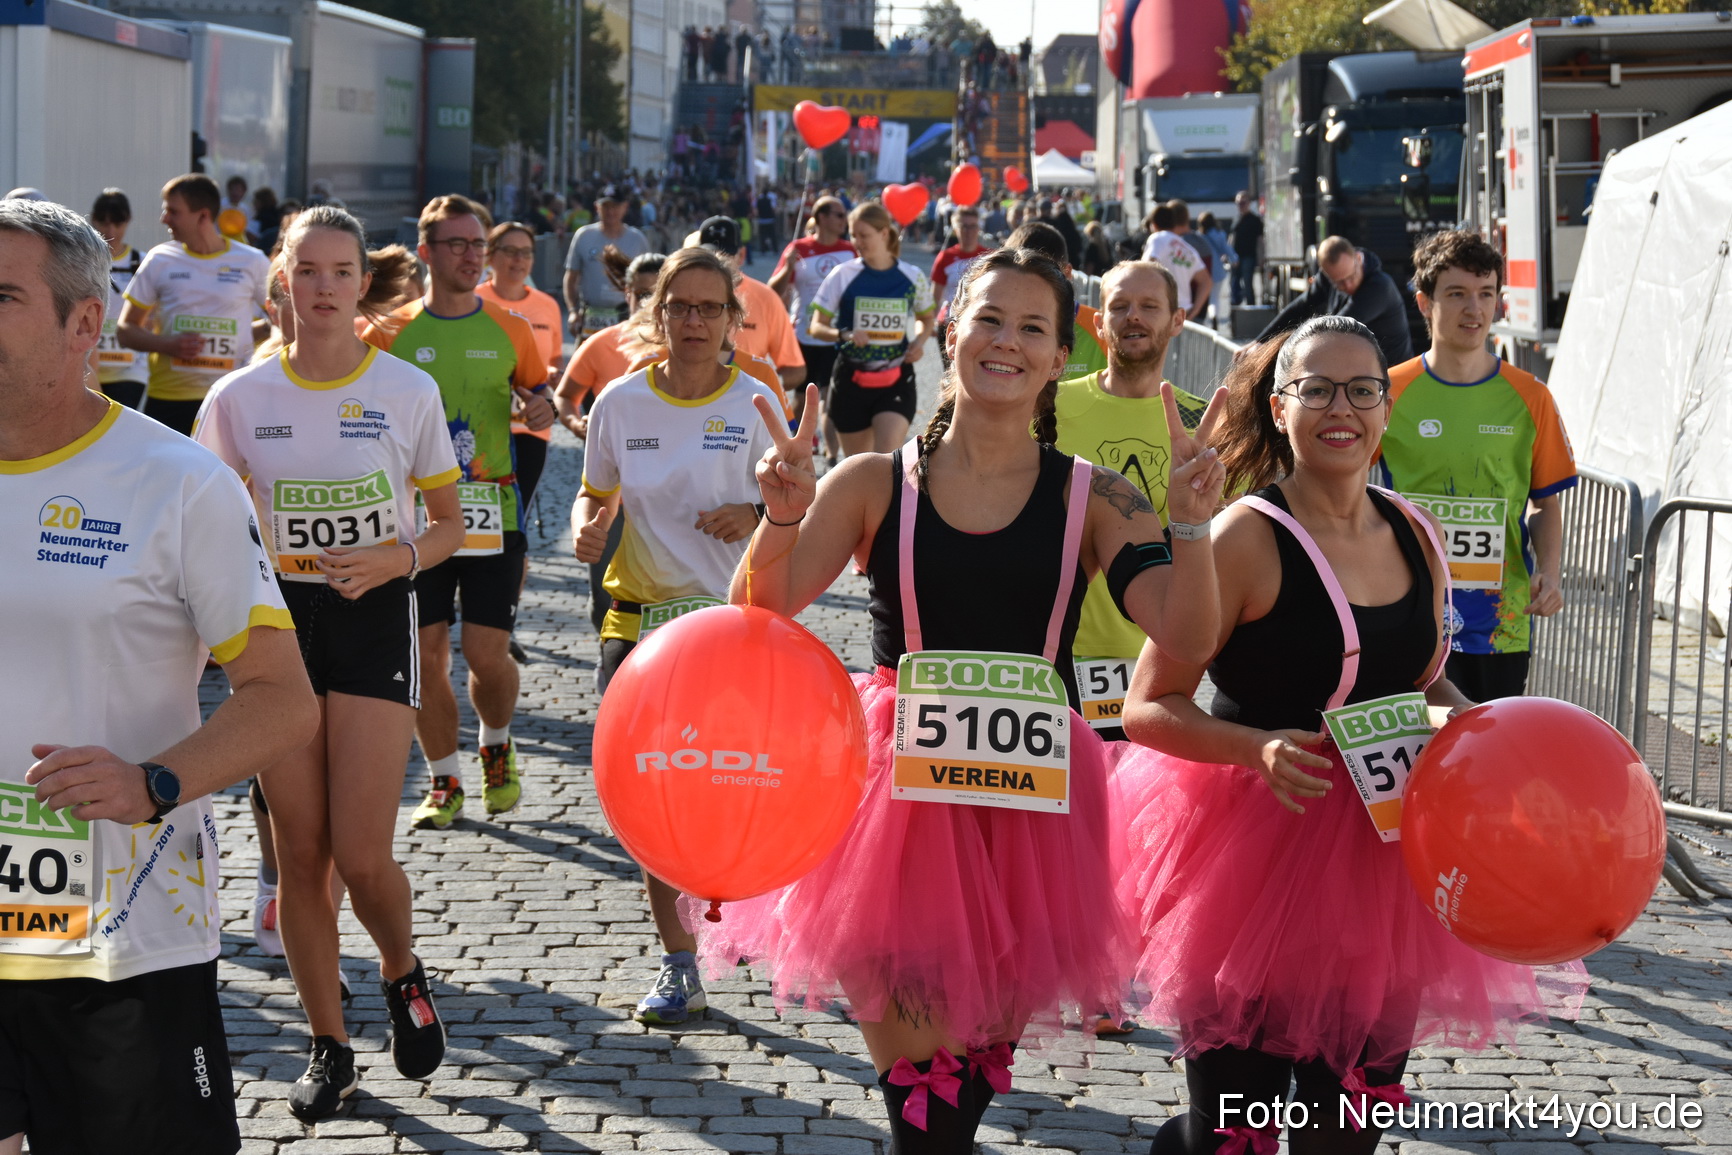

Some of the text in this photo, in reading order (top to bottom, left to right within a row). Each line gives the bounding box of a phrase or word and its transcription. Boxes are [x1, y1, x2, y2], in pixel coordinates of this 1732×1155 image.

[820, 91, 889, 110] START
[180, 316, 231, 333] BOCK
[861, 314, 900, 329] 5209
[341, 404, 384, 420] 20 JAHRE
[255, 426, 292, 437] BOCK
[340, 420, 391, 431] Neumarkter
[705, 420, 725, 433] 20
[1479, 424, 1514, 435] BOCK
[340, 430, 381, 440] Stadtlauf
[627, 438, 659, 447] BOCK
[703, 434, 749, 444] Neumarkter
[702, 443, 738, 453] Stadtlauf
[281, 476, 386, 508] BOCK
[43, 503, 119, 533] 20 JAHRE
[288, 510, 381, 549] 5031
[40, 532, 129, 553] Neumarkter
[37, 549, 108, 569] Stadtlauf
[911, 658, 1058, 699] BOCK
[1097, 703, 1124, 716] NO
[916, 704, 1053, 757] 5106
[1336, 700, 1432, 744] BOCK
[711, 772, 781, 788] energie
[929, 765, 1036, 791] VERENA
[0, 844, 68, 895] 40
[101, 823, 175, 939] 14./15. september 2019
[193, 1046, 212, 1098] adidas
